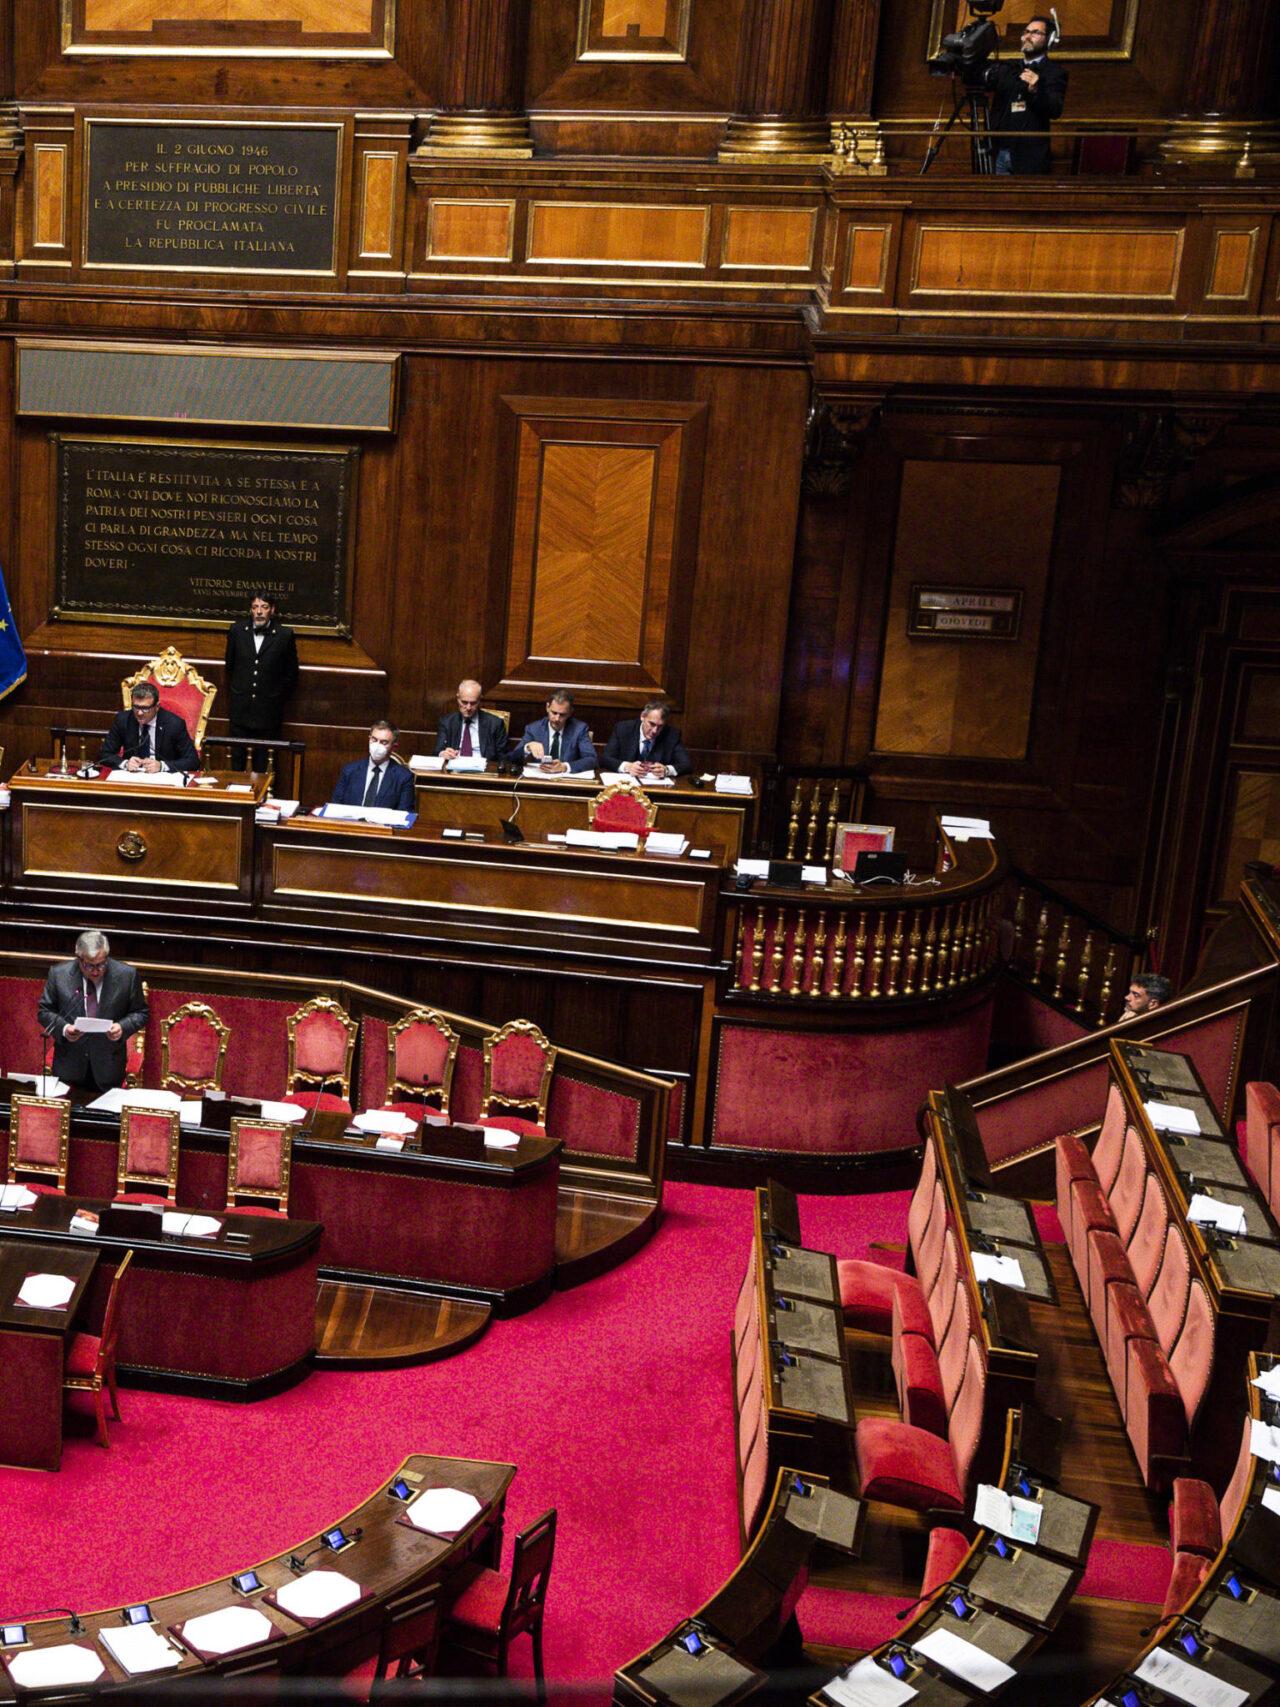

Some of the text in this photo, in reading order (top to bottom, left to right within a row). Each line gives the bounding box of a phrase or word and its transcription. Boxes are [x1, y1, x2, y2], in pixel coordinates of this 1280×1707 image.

[156, 144, 268, 156] IL 2 GIUGNO 1946
[125, 162, 298, 176] PER SUFFRAGIO DI POPOLO
[104, 180, 111, 191] A
[116, 181, 172, 192] PRESIDIO
[177, 182, 189, 192] DI
[194, 182, 260, 194] PUBBLICHE
[94, 198, 328, 216] E A CERTEZZA DI PROGRESSO CIVILE
[156, 220, 264, 232] FU PROCLAMATA
[125, 237, 294, 252] LA REPUBBLICA ITALIANA
[226, 478, 232, 487] A
[238, 478, 251, 488] SE
[256, 479, 296, 490] STESSA
[301, 480, 308, 490] E
[312, 481, 320, 491] A
[86, 488, 120, 499] ROMA
[152, 491, 182, 502] DOVE
[187, 493, 208, 503] NOI
[211, 494, 300, 507] RICONOSCIAMO
[305, 498, 319, 509] LA
[86, 505, 319, 527] PATRIA DEI NOSTRI PENSIERI OGNI COSA
[85, 523, 318, 544] CI PARLA DI GRANDEZZA MA NEL TEMPO
[84, 540, 124, 551] STESSO
[128, 543, 157, 553] OGNI
[161, 544, 192, 555] COSA
[196, 546, 207, 556] CI
[211, 546, 261, 559] RICORDA
[274, 550, 316, 562] NOSTRI
[85, 557, 128, 569] DOVERI
[190, 578, 233, 589] VITTORIO
